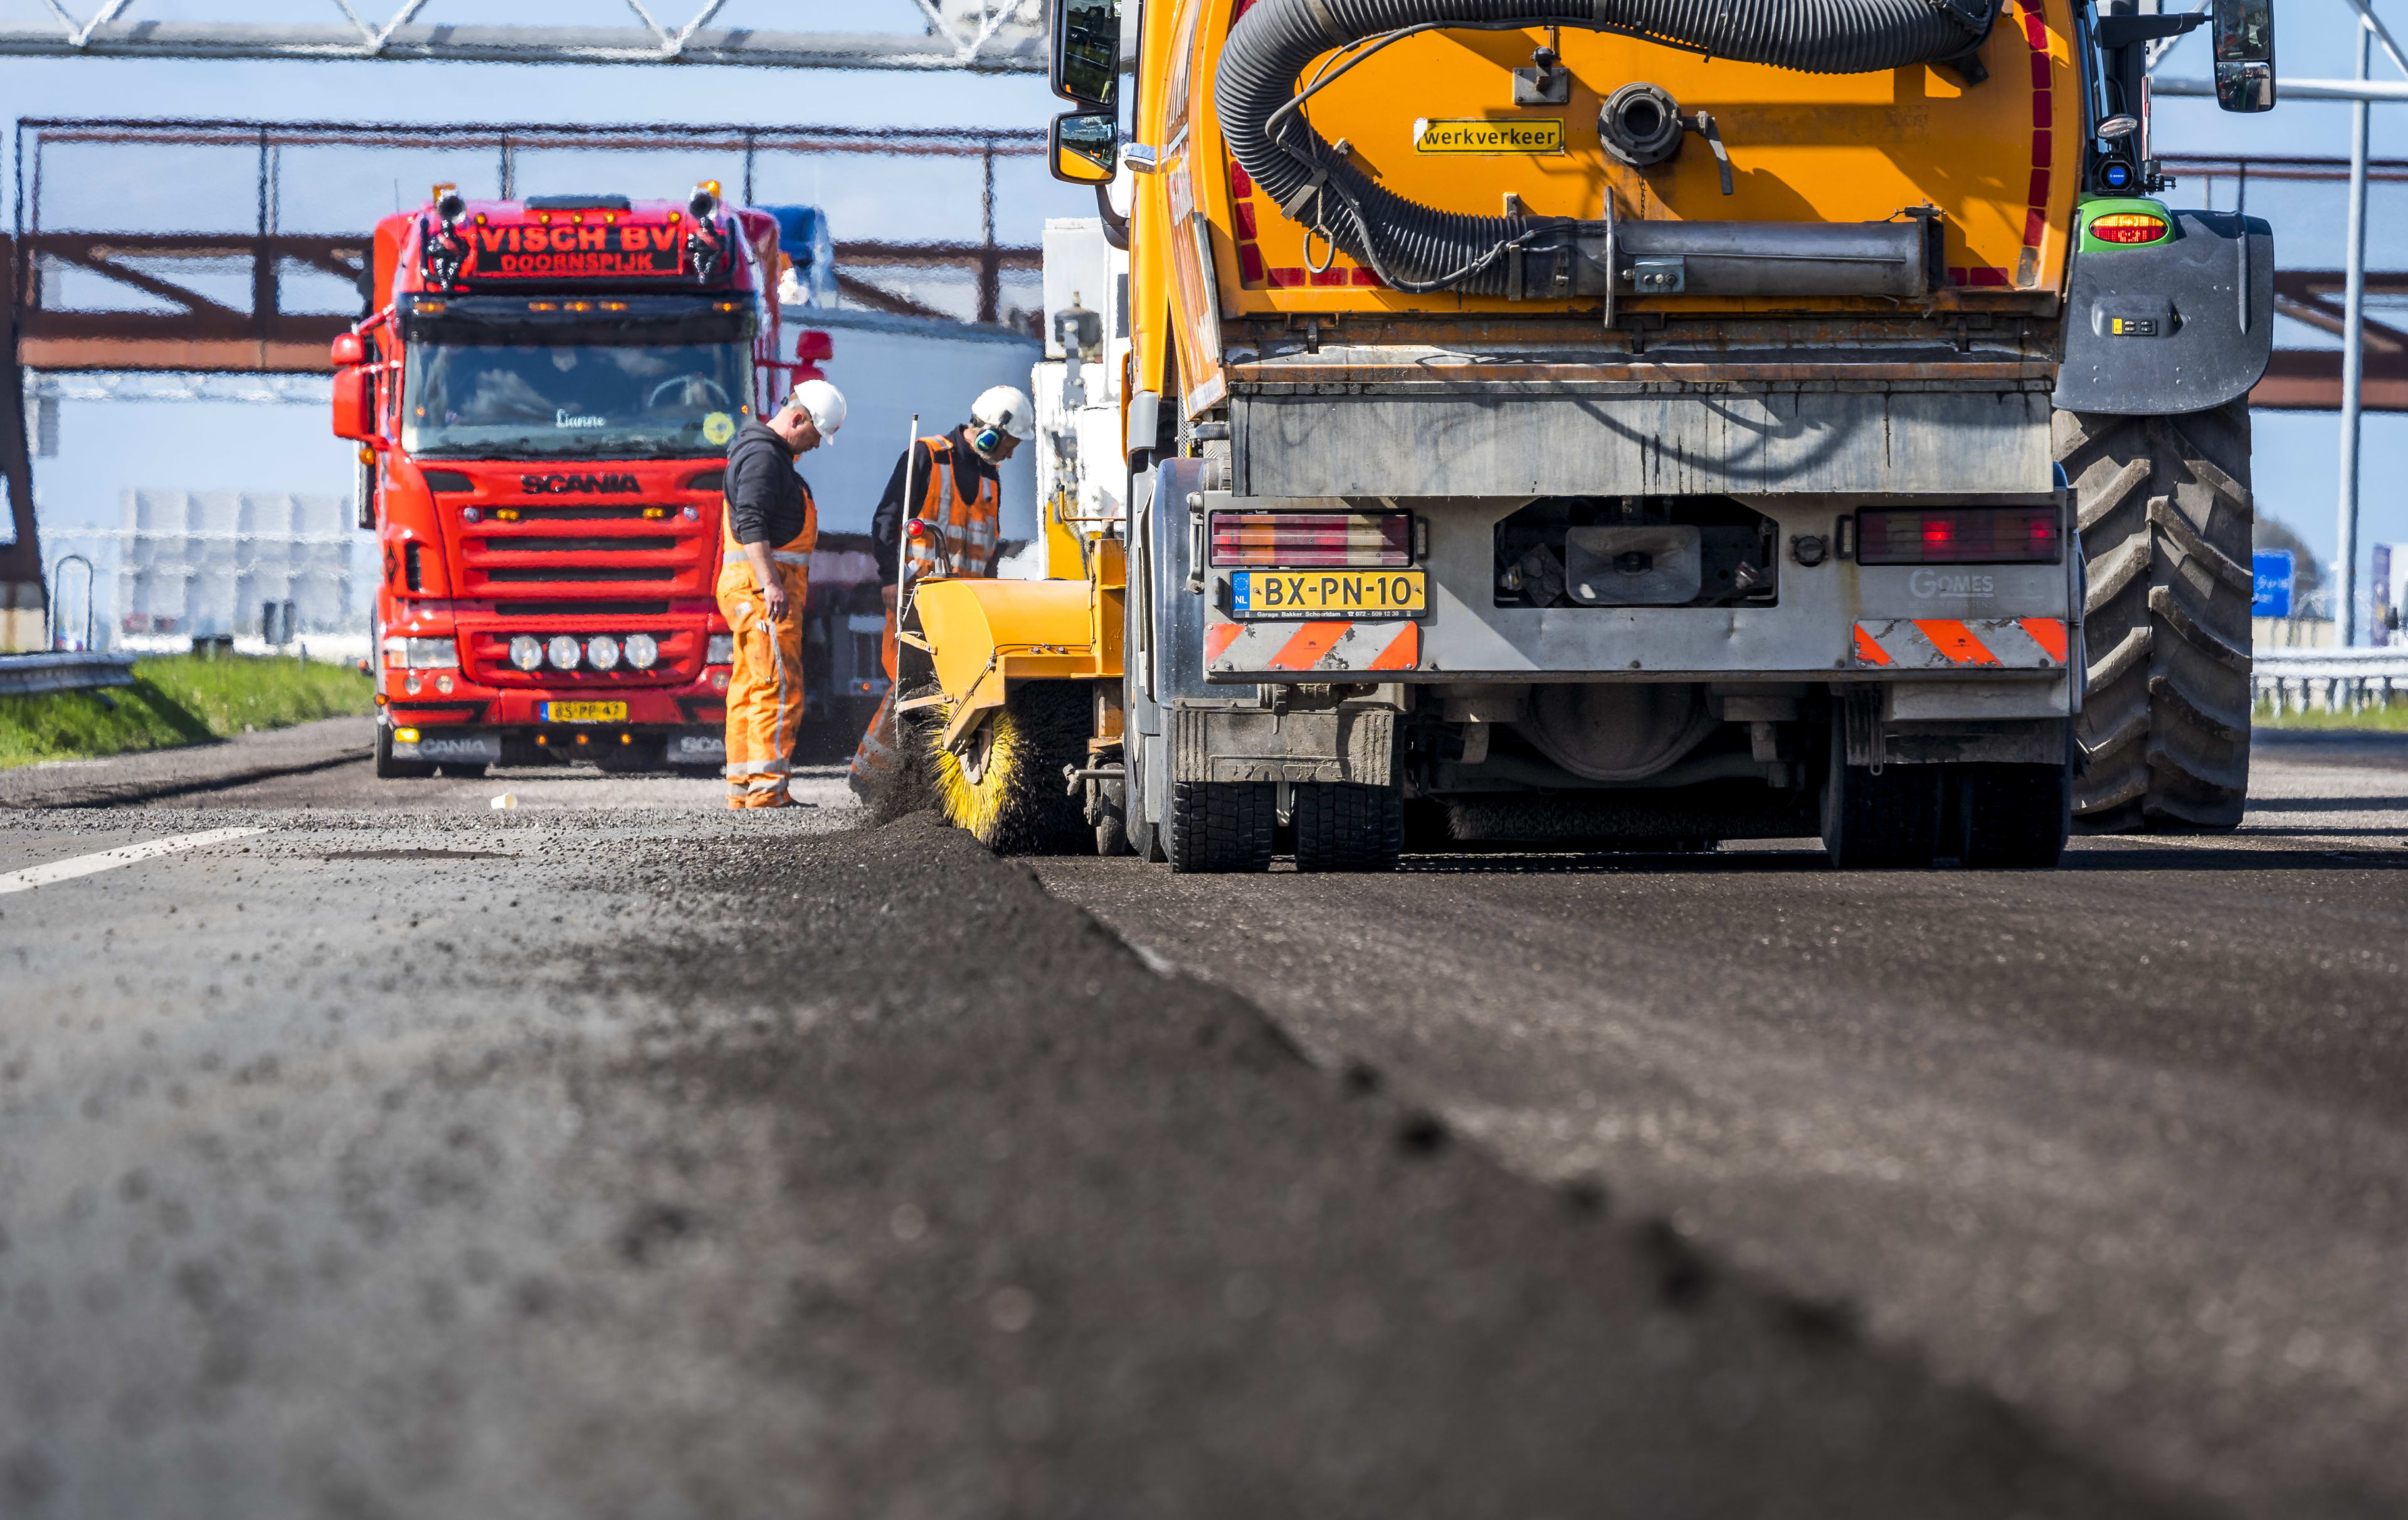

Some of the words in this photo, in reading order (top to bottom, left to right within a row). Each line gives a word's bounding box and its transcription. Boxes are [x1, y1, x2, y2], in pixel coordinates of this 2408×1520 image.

[1424, 128, 1555, 145] werkverkeer
[478, 226, 607, 252] VISCH
[620, 226, 678, 251] BV
[501, 253, 653, 270] DOORNSPIJK
[522, 473, 643, 494] SCANIA
[1265, 577, 1411, 605] BX-PN-10
[1235, 596, 1248, 604] NL
[420, 737, 487, 753] CANIA
